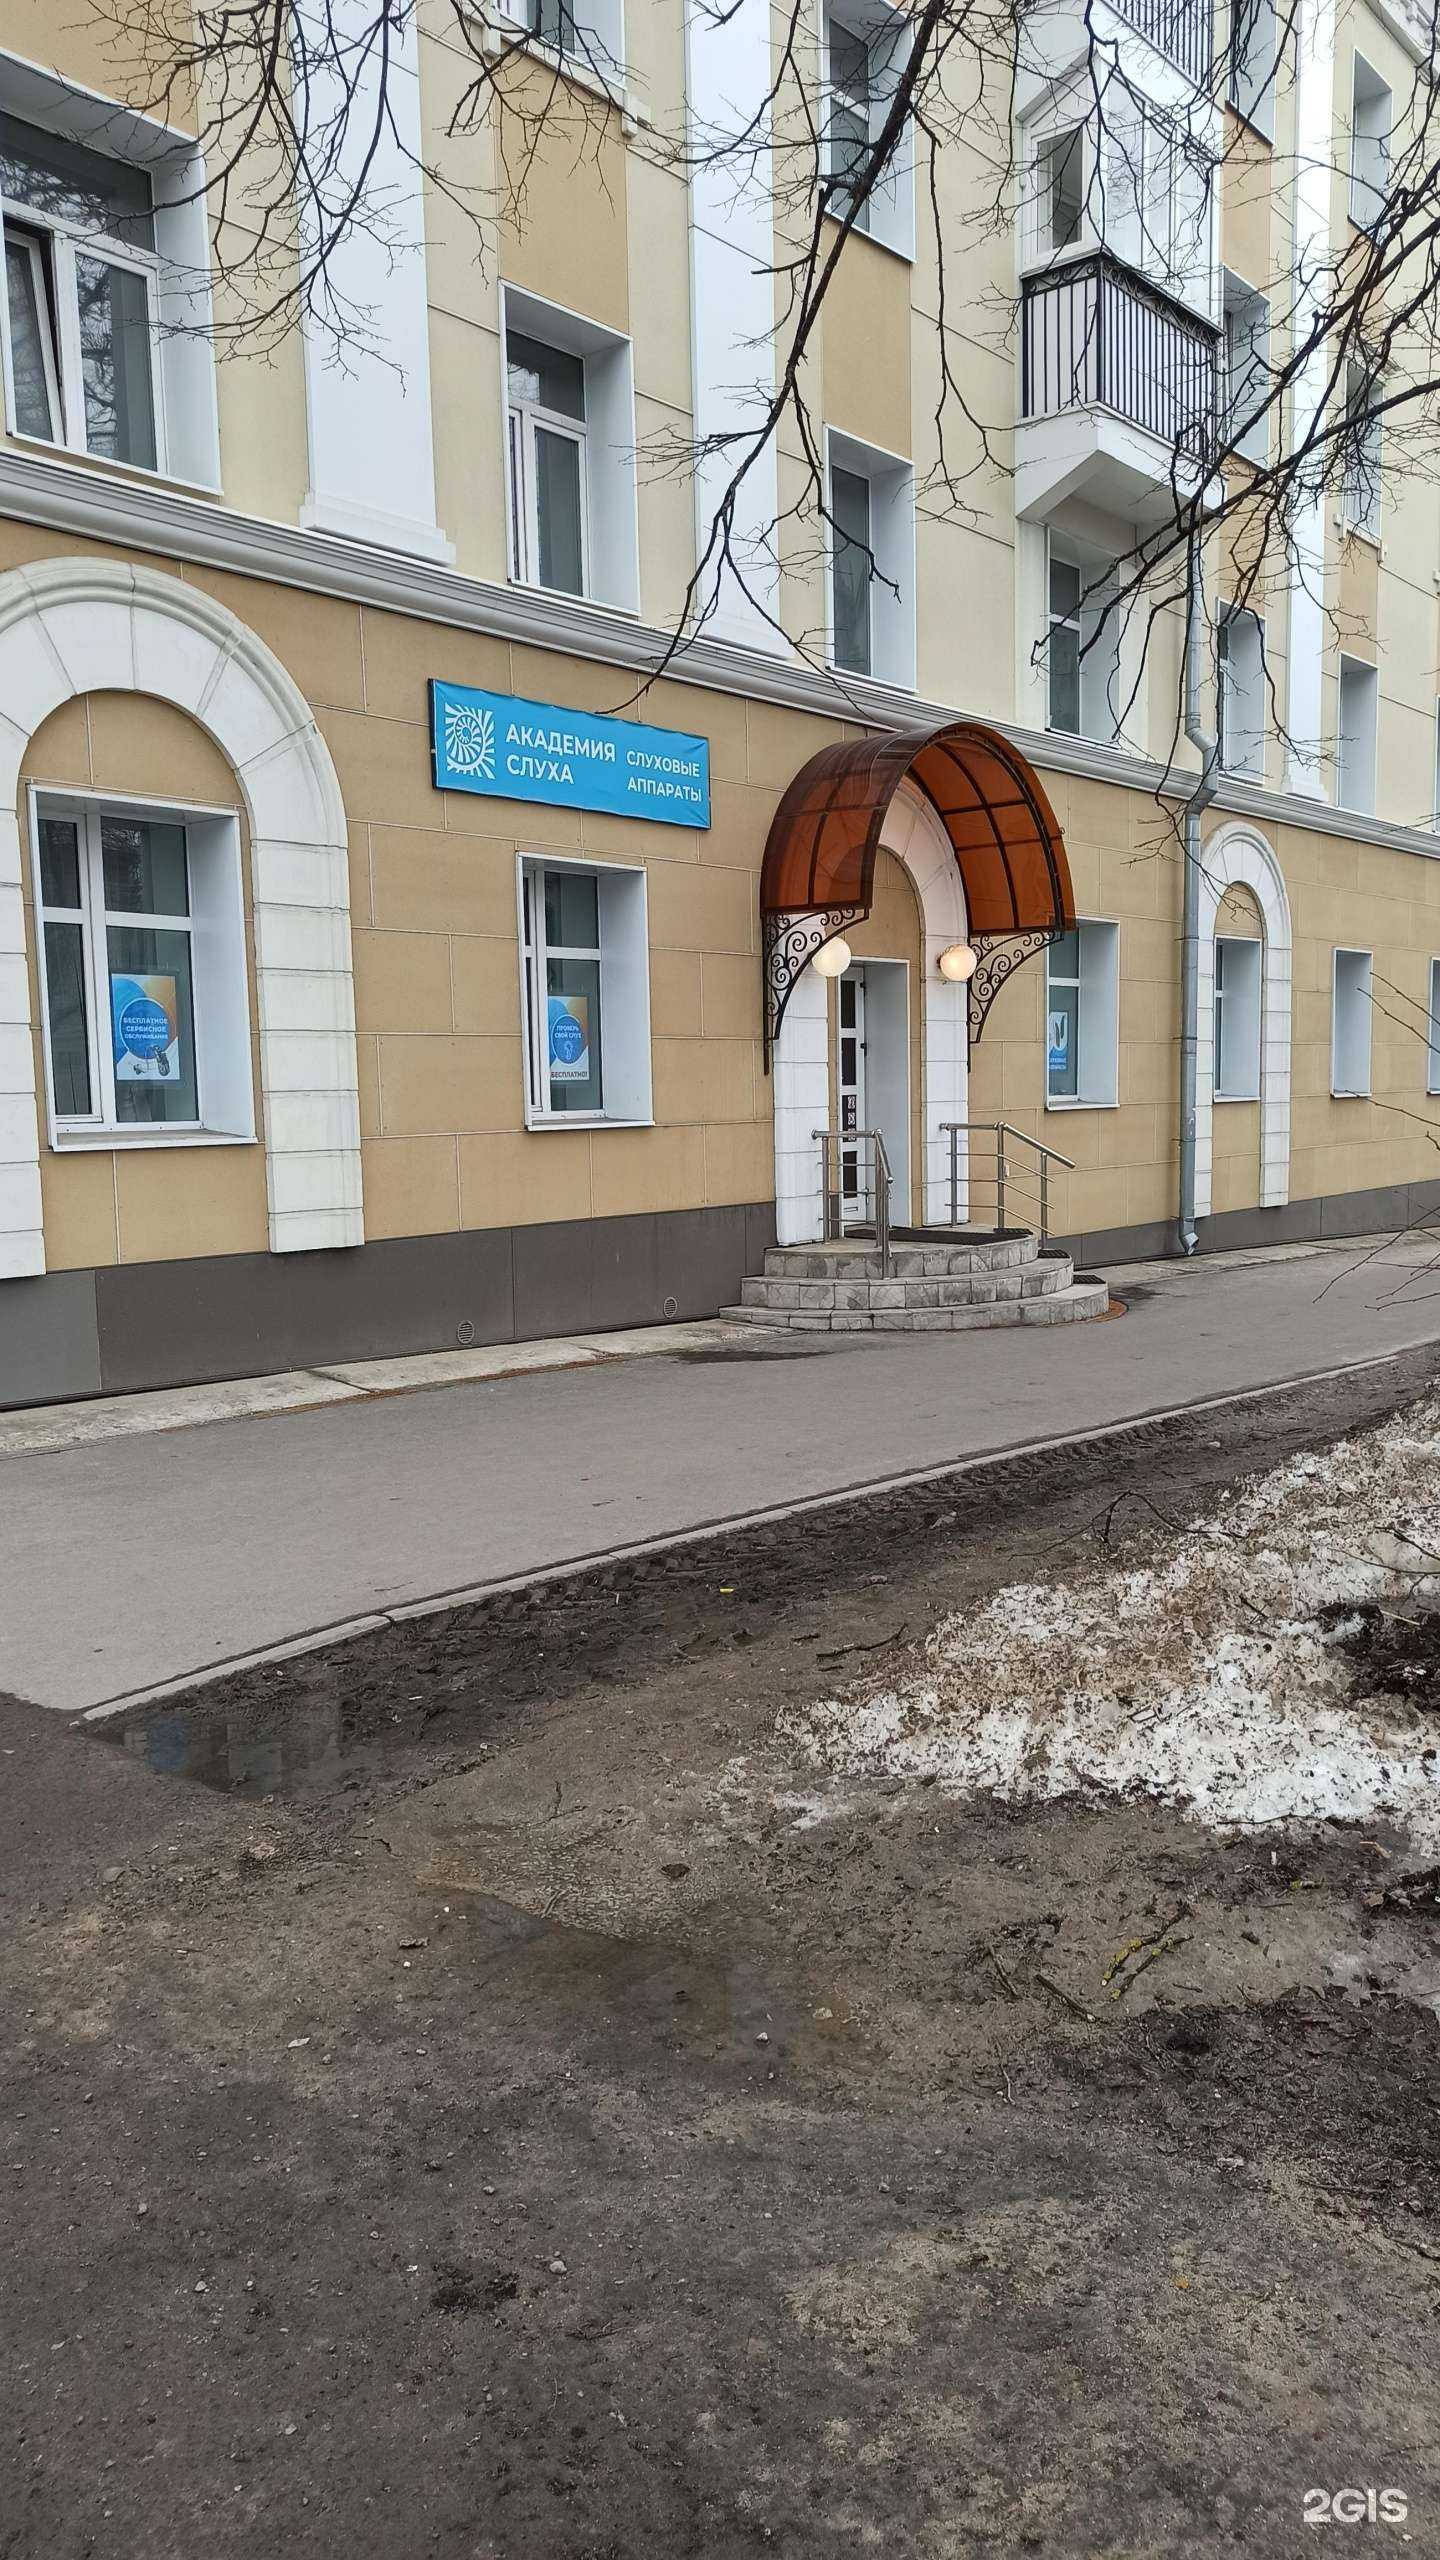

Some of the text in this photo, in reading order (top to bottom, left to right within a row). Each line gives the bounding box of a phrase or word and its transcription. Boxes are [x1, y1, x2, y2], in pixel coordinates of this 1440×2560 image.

[506, 723, 616, 763] АКАДЕМИЯ
[506, 754, 575, 785] СЛУХА
[626, 749, 701, 778] СЛУХОВЫЕ
[627, 776, 702, 803] АППАРАТЫ
[123, 1016, 168, 1025] БЕСПЛАТНОЕ
[126, 1025, 167, 1033] СЕРВИСНОЕ
